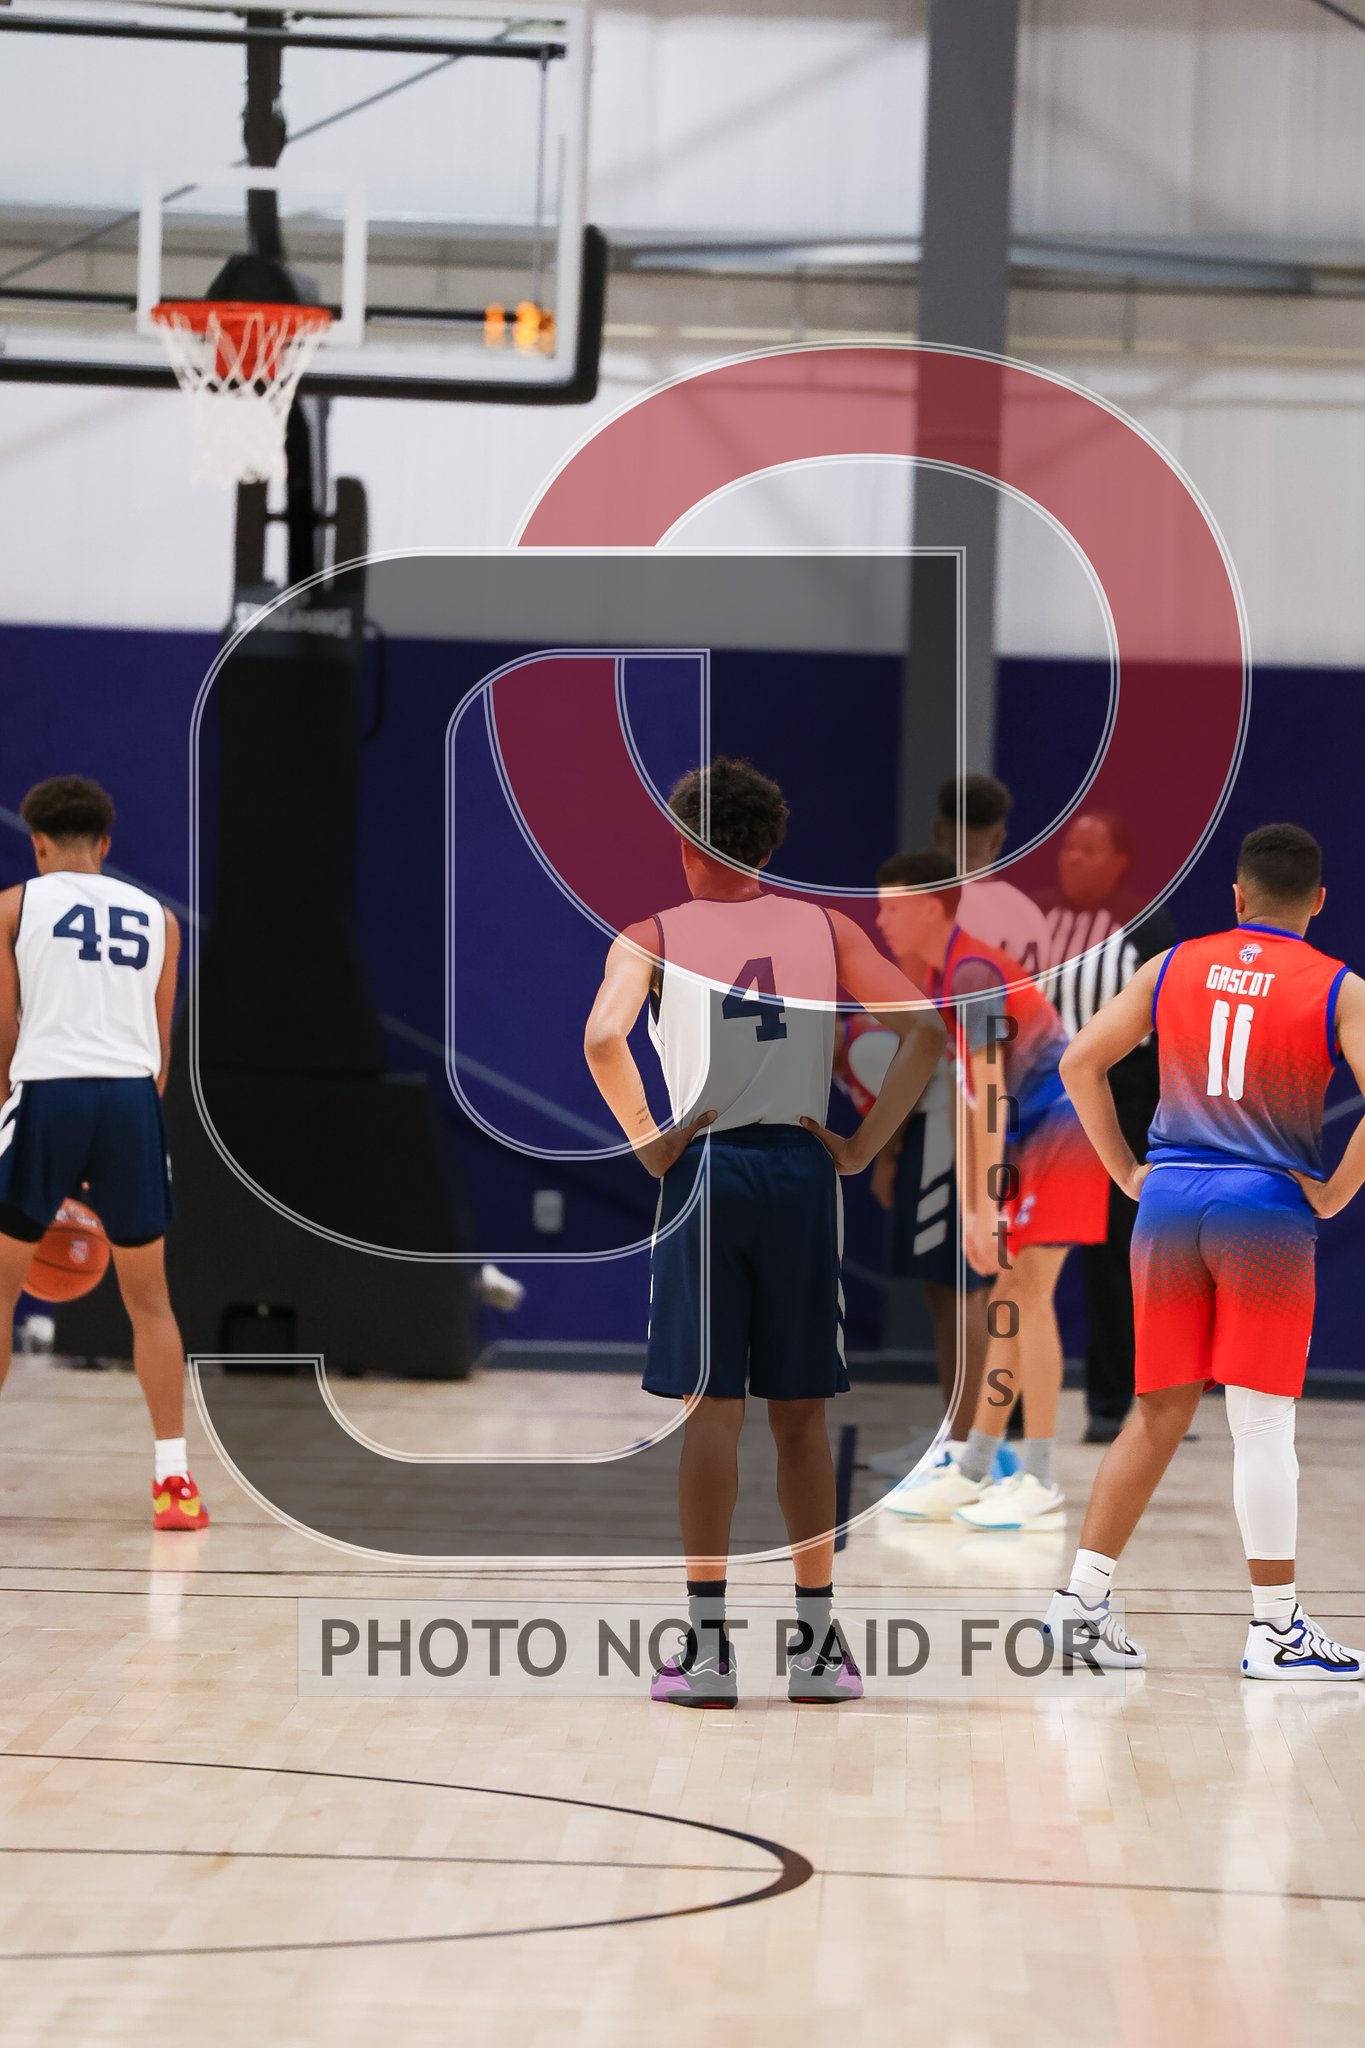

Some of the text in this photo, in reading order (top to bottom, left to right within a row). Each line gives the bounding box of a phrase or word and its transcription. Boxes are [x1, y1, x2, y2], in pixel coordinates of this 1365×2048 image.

[52, 904, 150, 971] 45
[722, 956, 788, 1043] 4
[1206, 964, 1276, 998] GASCOT
[1206, 999, 1254, 1101] 11
